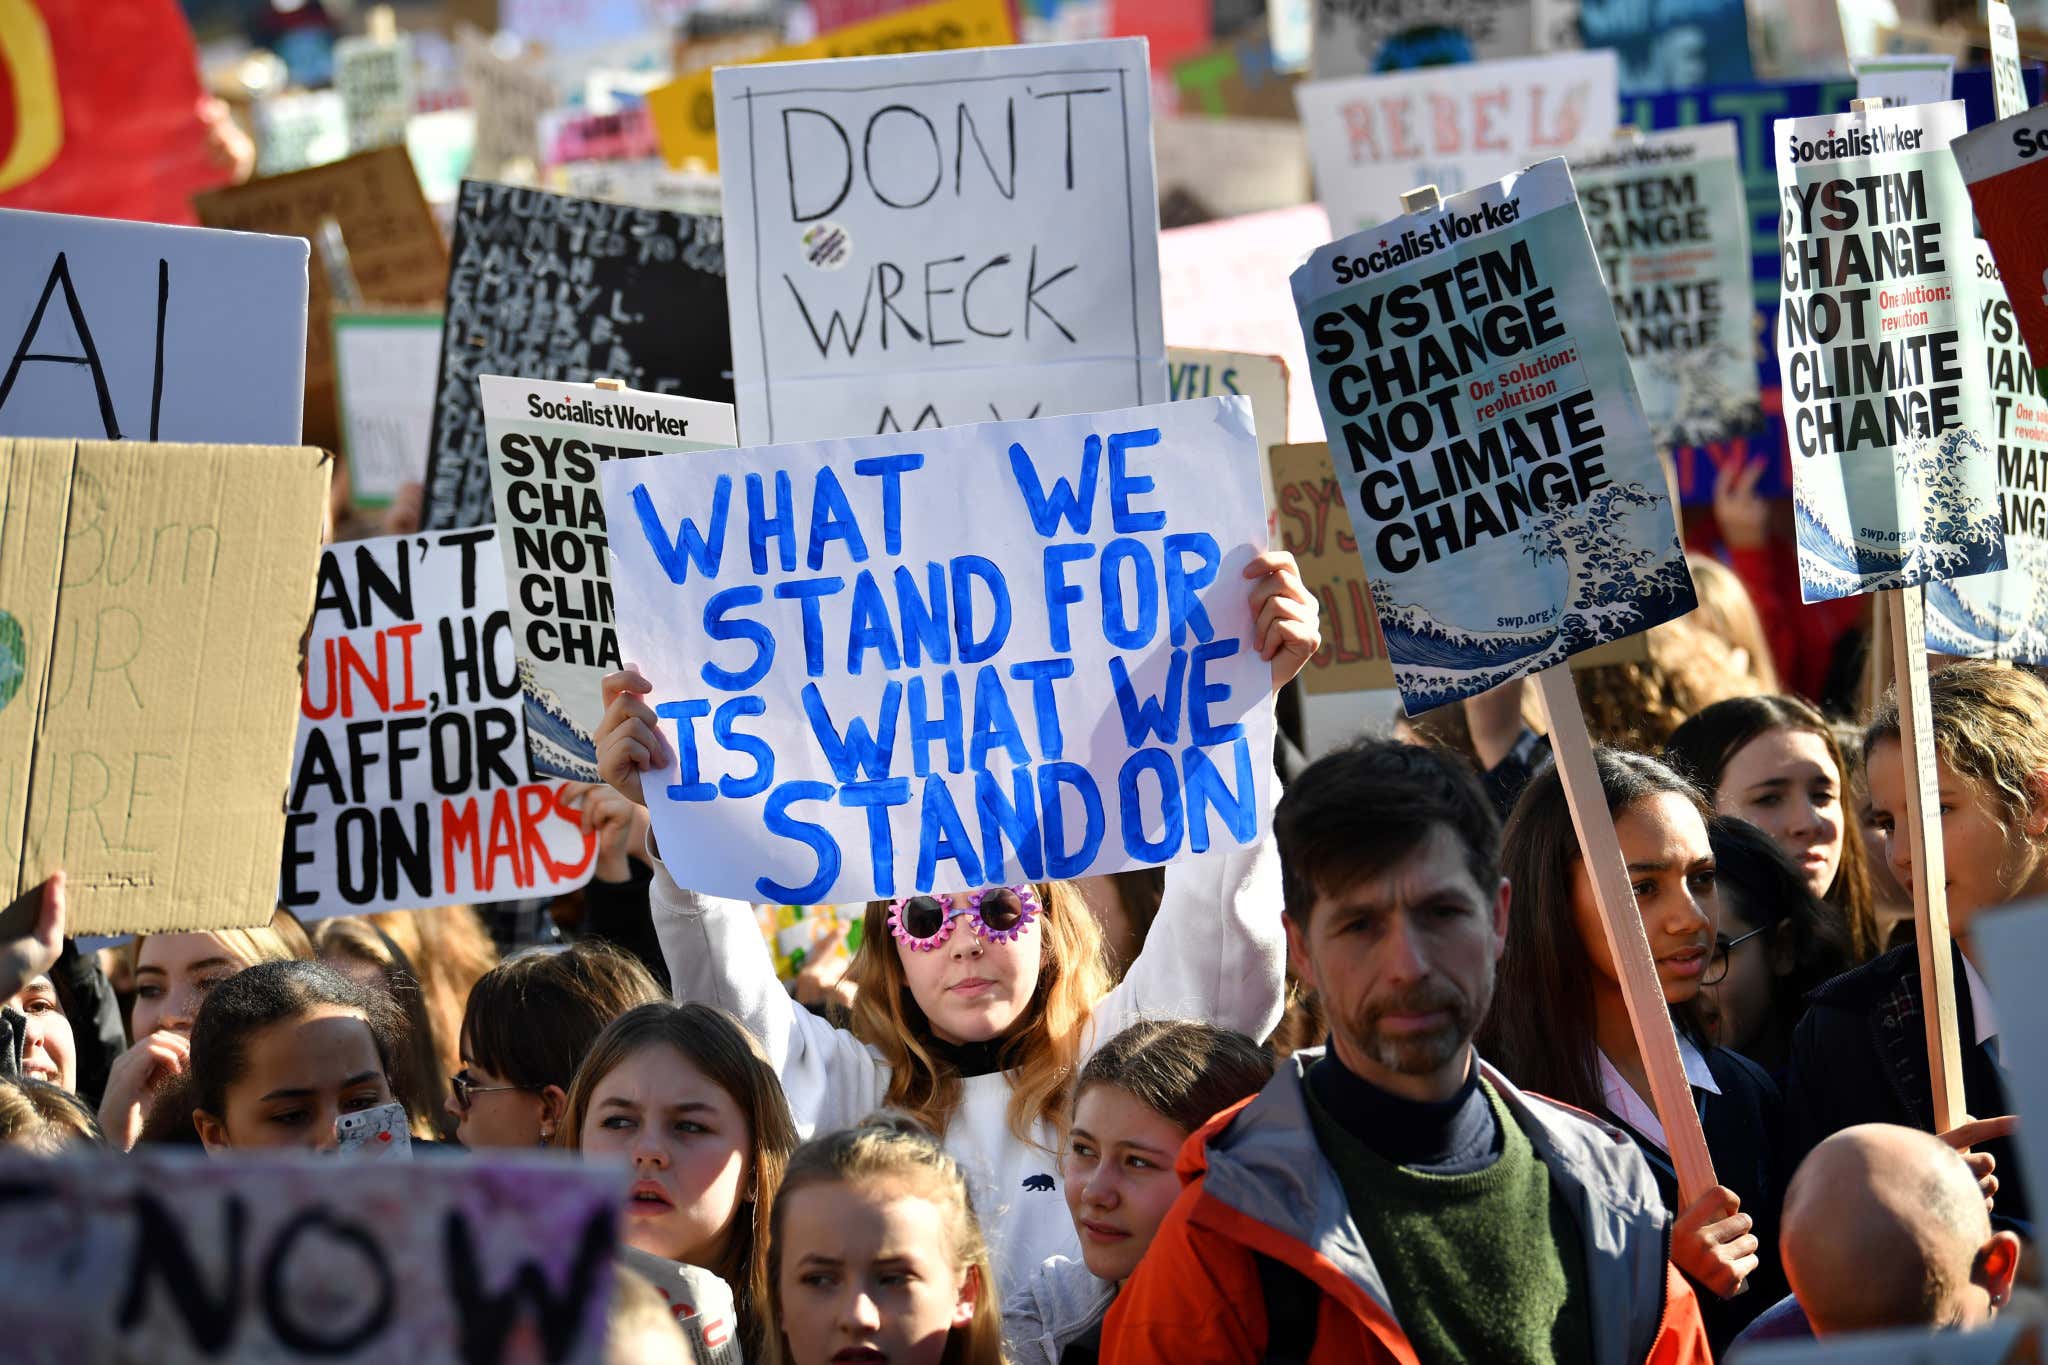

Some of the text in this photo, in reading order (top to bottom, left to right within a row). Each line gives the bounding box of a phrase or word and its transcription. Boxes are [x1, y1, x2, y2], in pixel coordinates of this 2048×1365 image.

[782, 86, 1111, 222] DON'T
[1789, 128, 1879, 164] Socialist
[1577, 171, 1698, 218] STEM
[1590, 205, 1713, 250] ANGE
[1782, 170, 1928, 237] SYSTEM
[1332, 223, 1445, 285] Socialist
[1783, 223, 1945, 293] CHANGE
[783, 245, 1077, 359] WRECK
[1313, 239, 1538, 366] SYSTEM
[1783, 288, 1871, 349] NOT
[1901, 285, 1951, 311] olution:
[1328, 287, 1566, 417] CHANGE
[1469, 346, 1577, 402] On solution:
[1789, 329, 1963, 404] CLIMATE
[500, 433, 663, 484] SYS
[527, 393, 689, 437] Socialist Worker
[1342, 387, 1462, 474] NOT
[1360, 389, 1605, 522] CLIMATE
[1795, 384, 1963, 458] CHANGE
[51, 468, 221, 590] Burn
[628, 453, 925, 585] WHAT
[1008, 428, 1167, 538] WE
[1375, 444, 1613, 574] CHANGE
[513, 527, 610, 577] NOT
[701, 532, 1221, 692] STAND FOR
[290, 705, 550, 812] AFFOR
[656, 637, 1247, 802] IS WHAT WE
[334, 803, 433, 905] ON
[442, 782, 597, 895] MARS
[755, 737, 1258, 906] STAND ON
[115, 1185, 618, 1365] NOW
